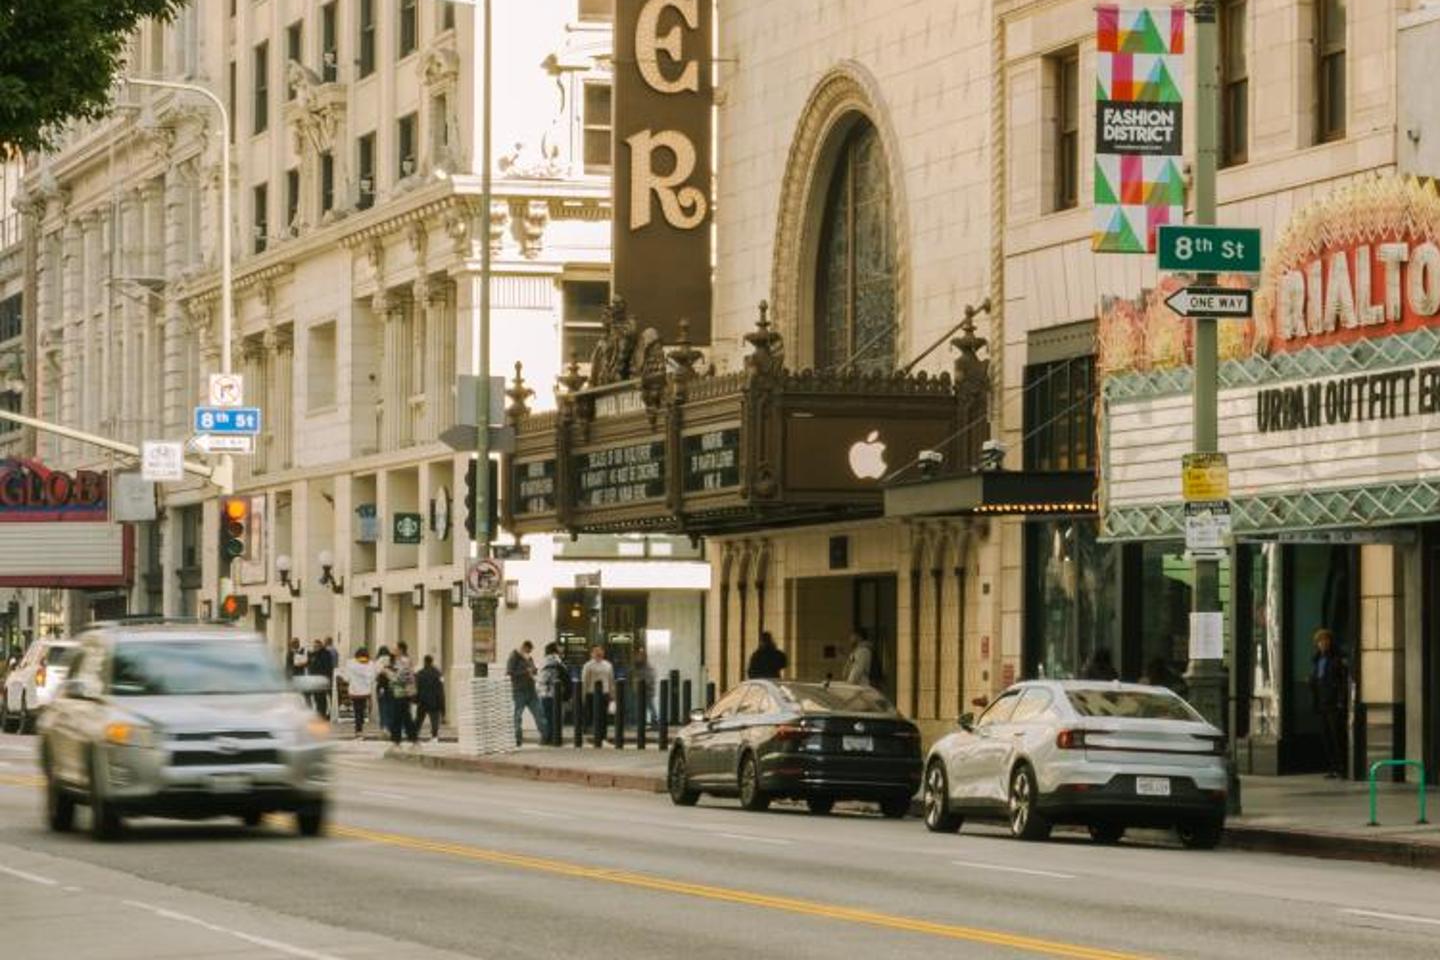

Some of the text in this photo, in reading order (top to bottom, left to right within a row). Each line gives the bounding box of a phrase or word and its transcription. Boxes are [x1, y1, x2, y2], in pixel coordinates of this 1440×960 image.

[1103, 108, 1174, 125] FASHION
[1104, 125, 1173, 142] DISTRICT
[1175, 236, 1244, 260] 8th St
[1190, 297, 1244, 308] ONE WAY
[1257, 382, 1321, 432] URBAN
[201, 412, 254, 429] 8th St
